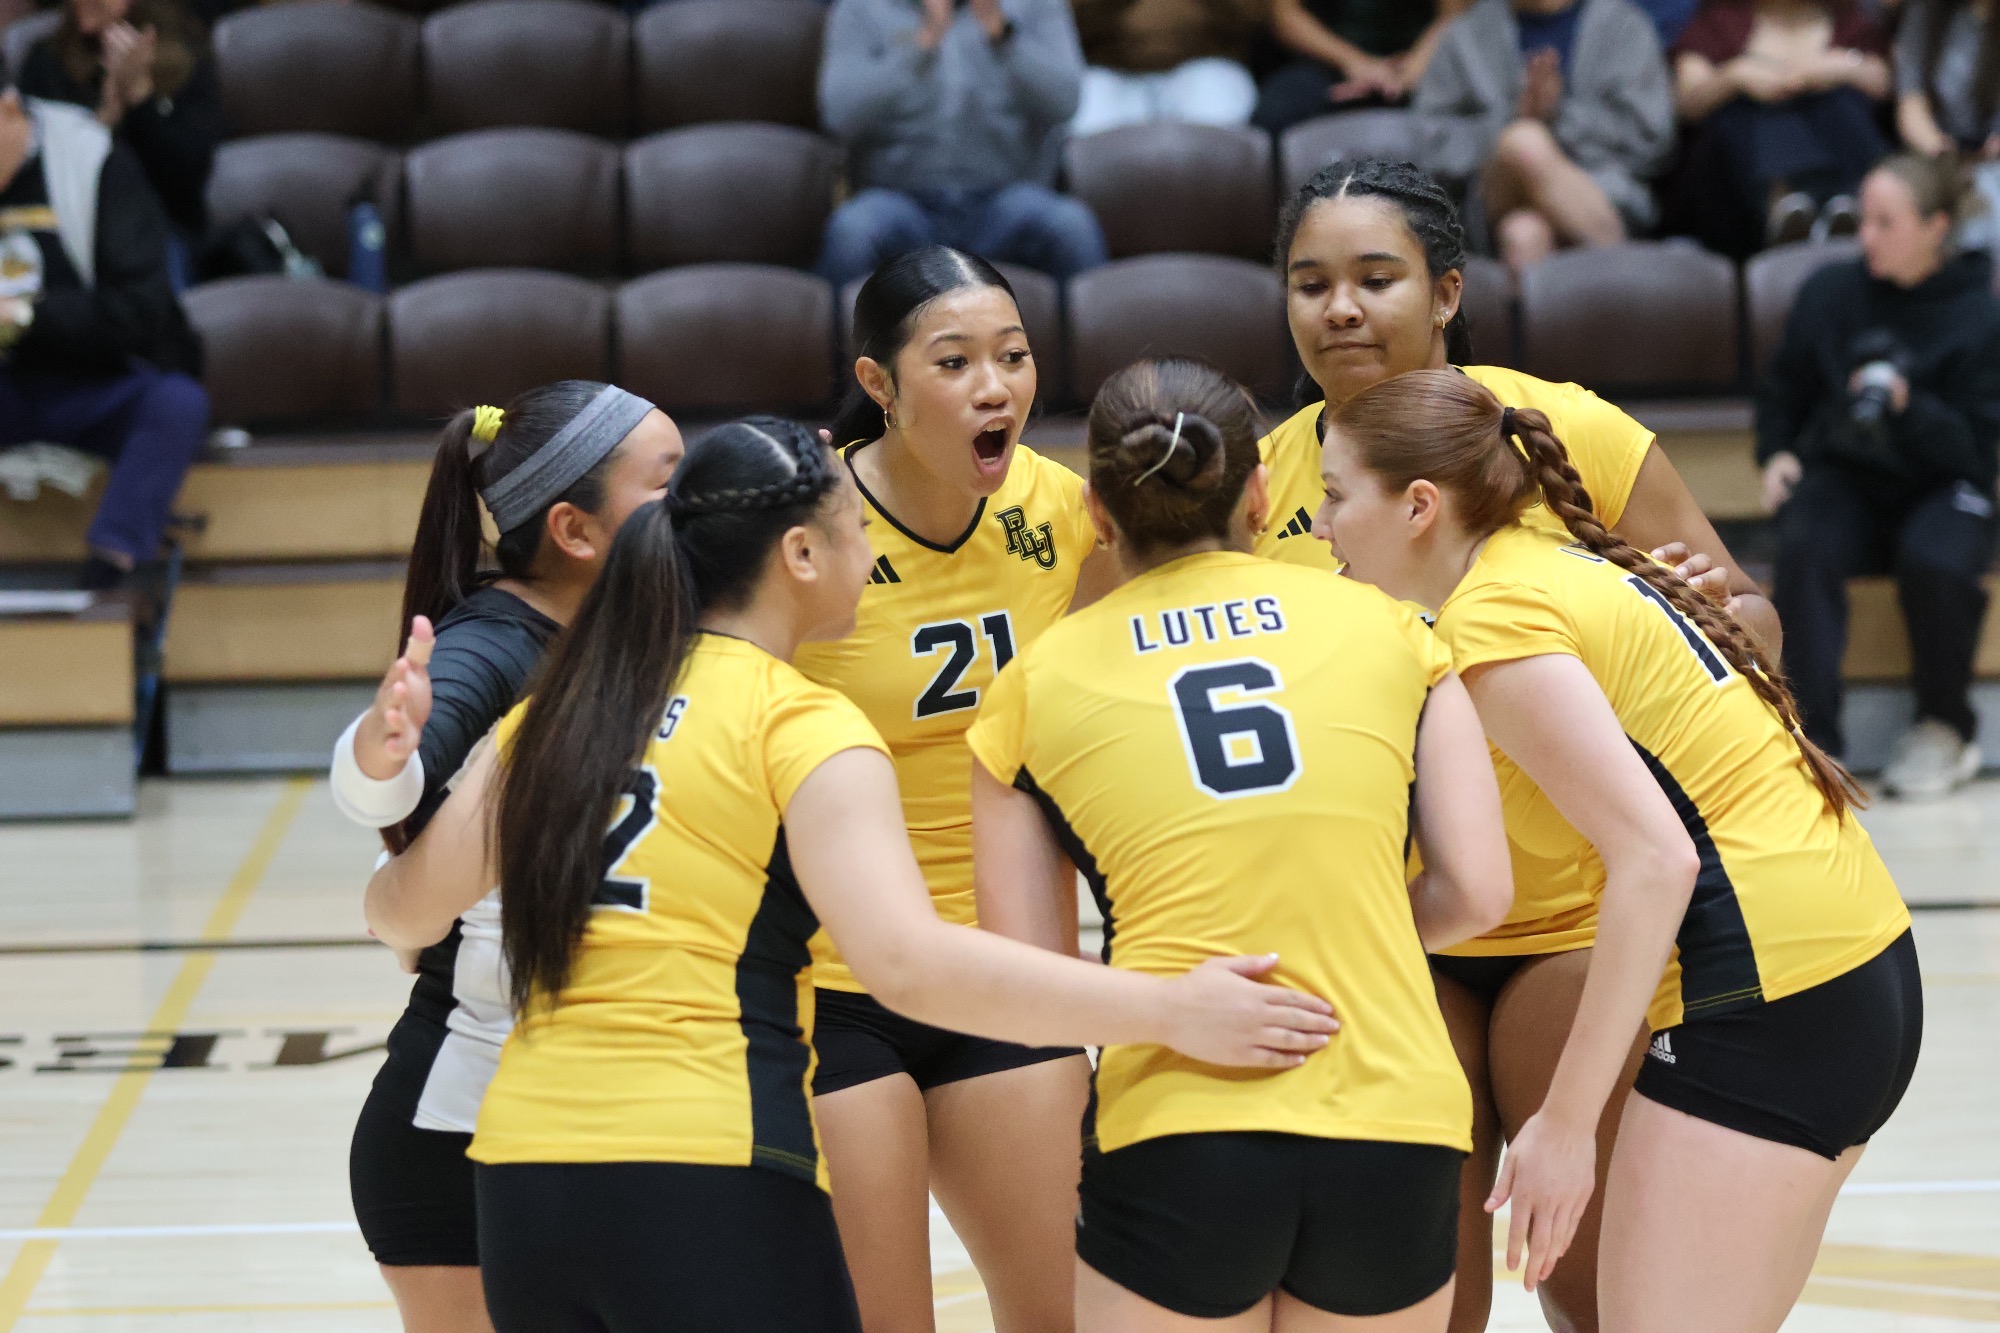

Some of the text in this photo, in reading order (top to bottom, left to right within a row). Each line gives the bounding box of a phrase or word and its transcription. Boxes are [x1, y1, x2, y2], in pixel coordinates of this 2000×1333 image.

[994, 504, 1058, 571] PLU
[910, 608, 1017, 722] 21
[1130, 594, 1287, 655] LUTES
[1165, 655, 1304, 801] 6
